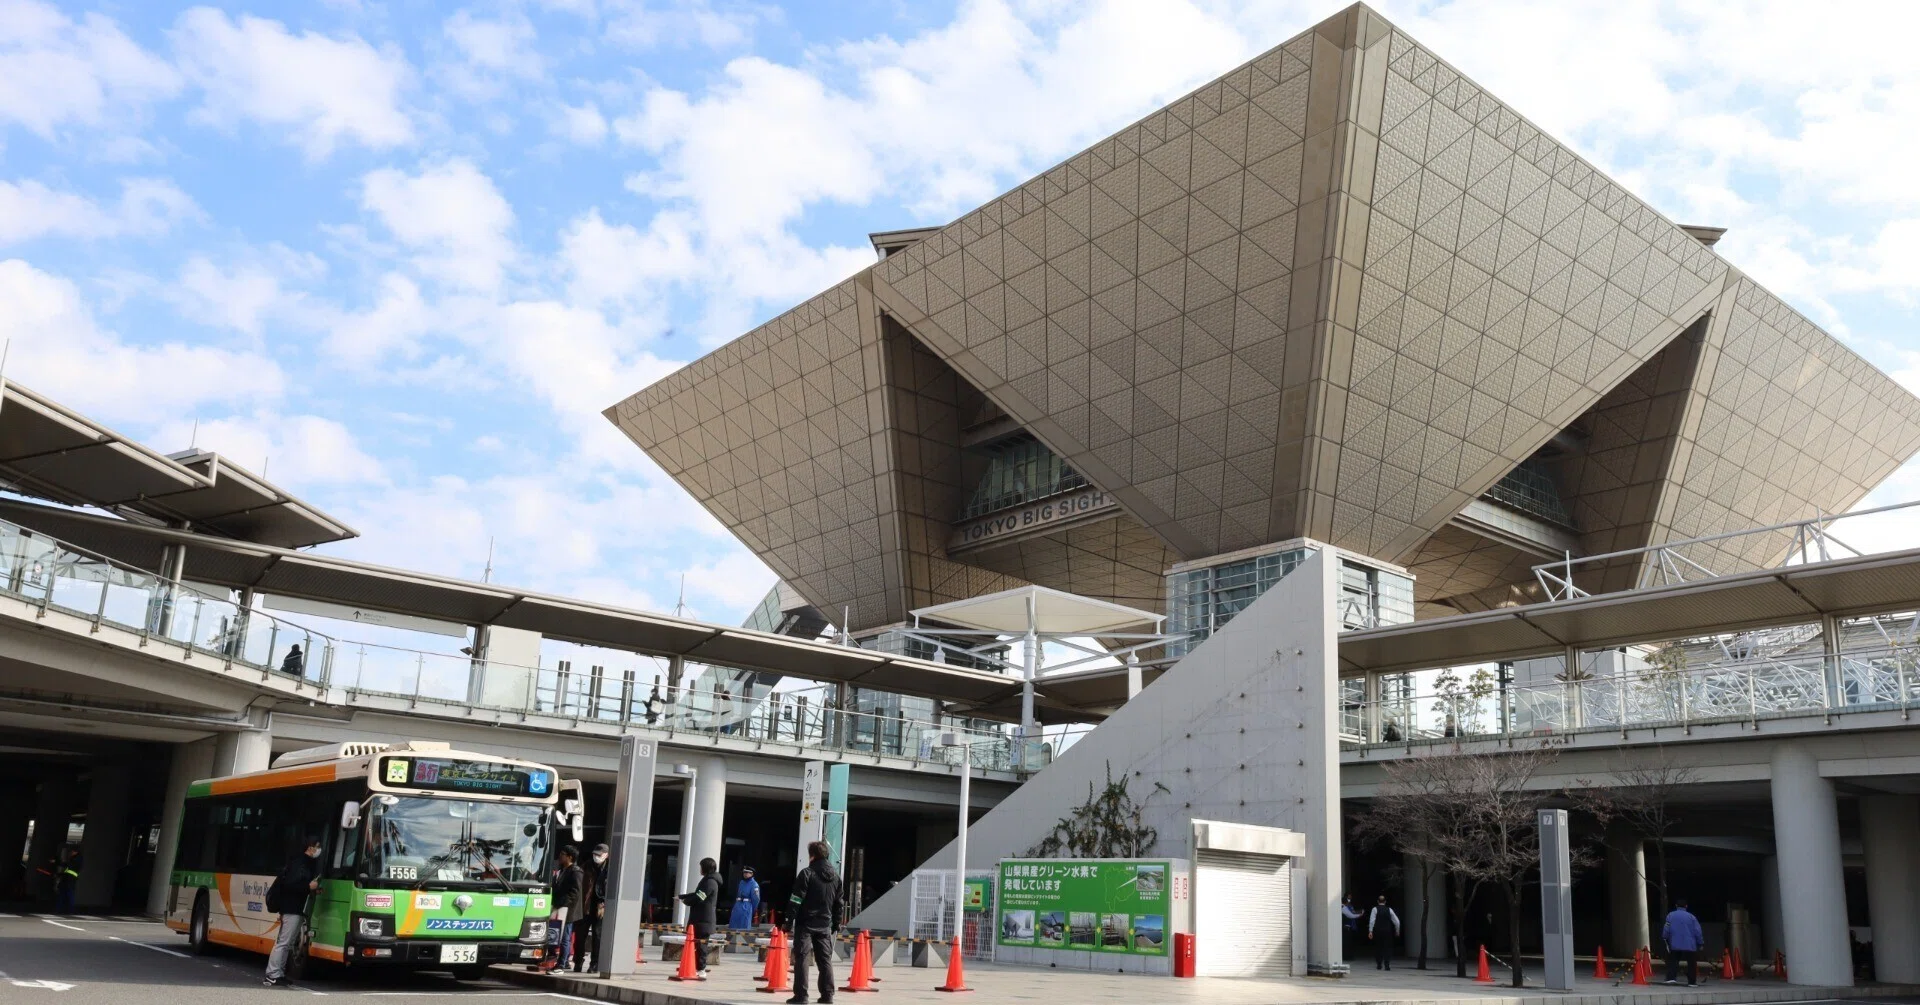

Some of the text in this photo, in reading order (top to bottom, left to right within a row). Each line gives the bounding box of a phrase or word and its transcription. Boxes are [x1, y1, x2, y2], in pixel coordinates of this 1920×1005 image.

[962, 491, 1112, 541] TOKYO BIG SIGH
[641, 745, 648, 756] 8
[390, 867, 417, 880] F556
[1004, 865, 1098, 878] 山梨県産グリーン水素で
[1004, 878, 1062, 891] 発電しています
[427, 919, 493, 930] ノンステップバス
